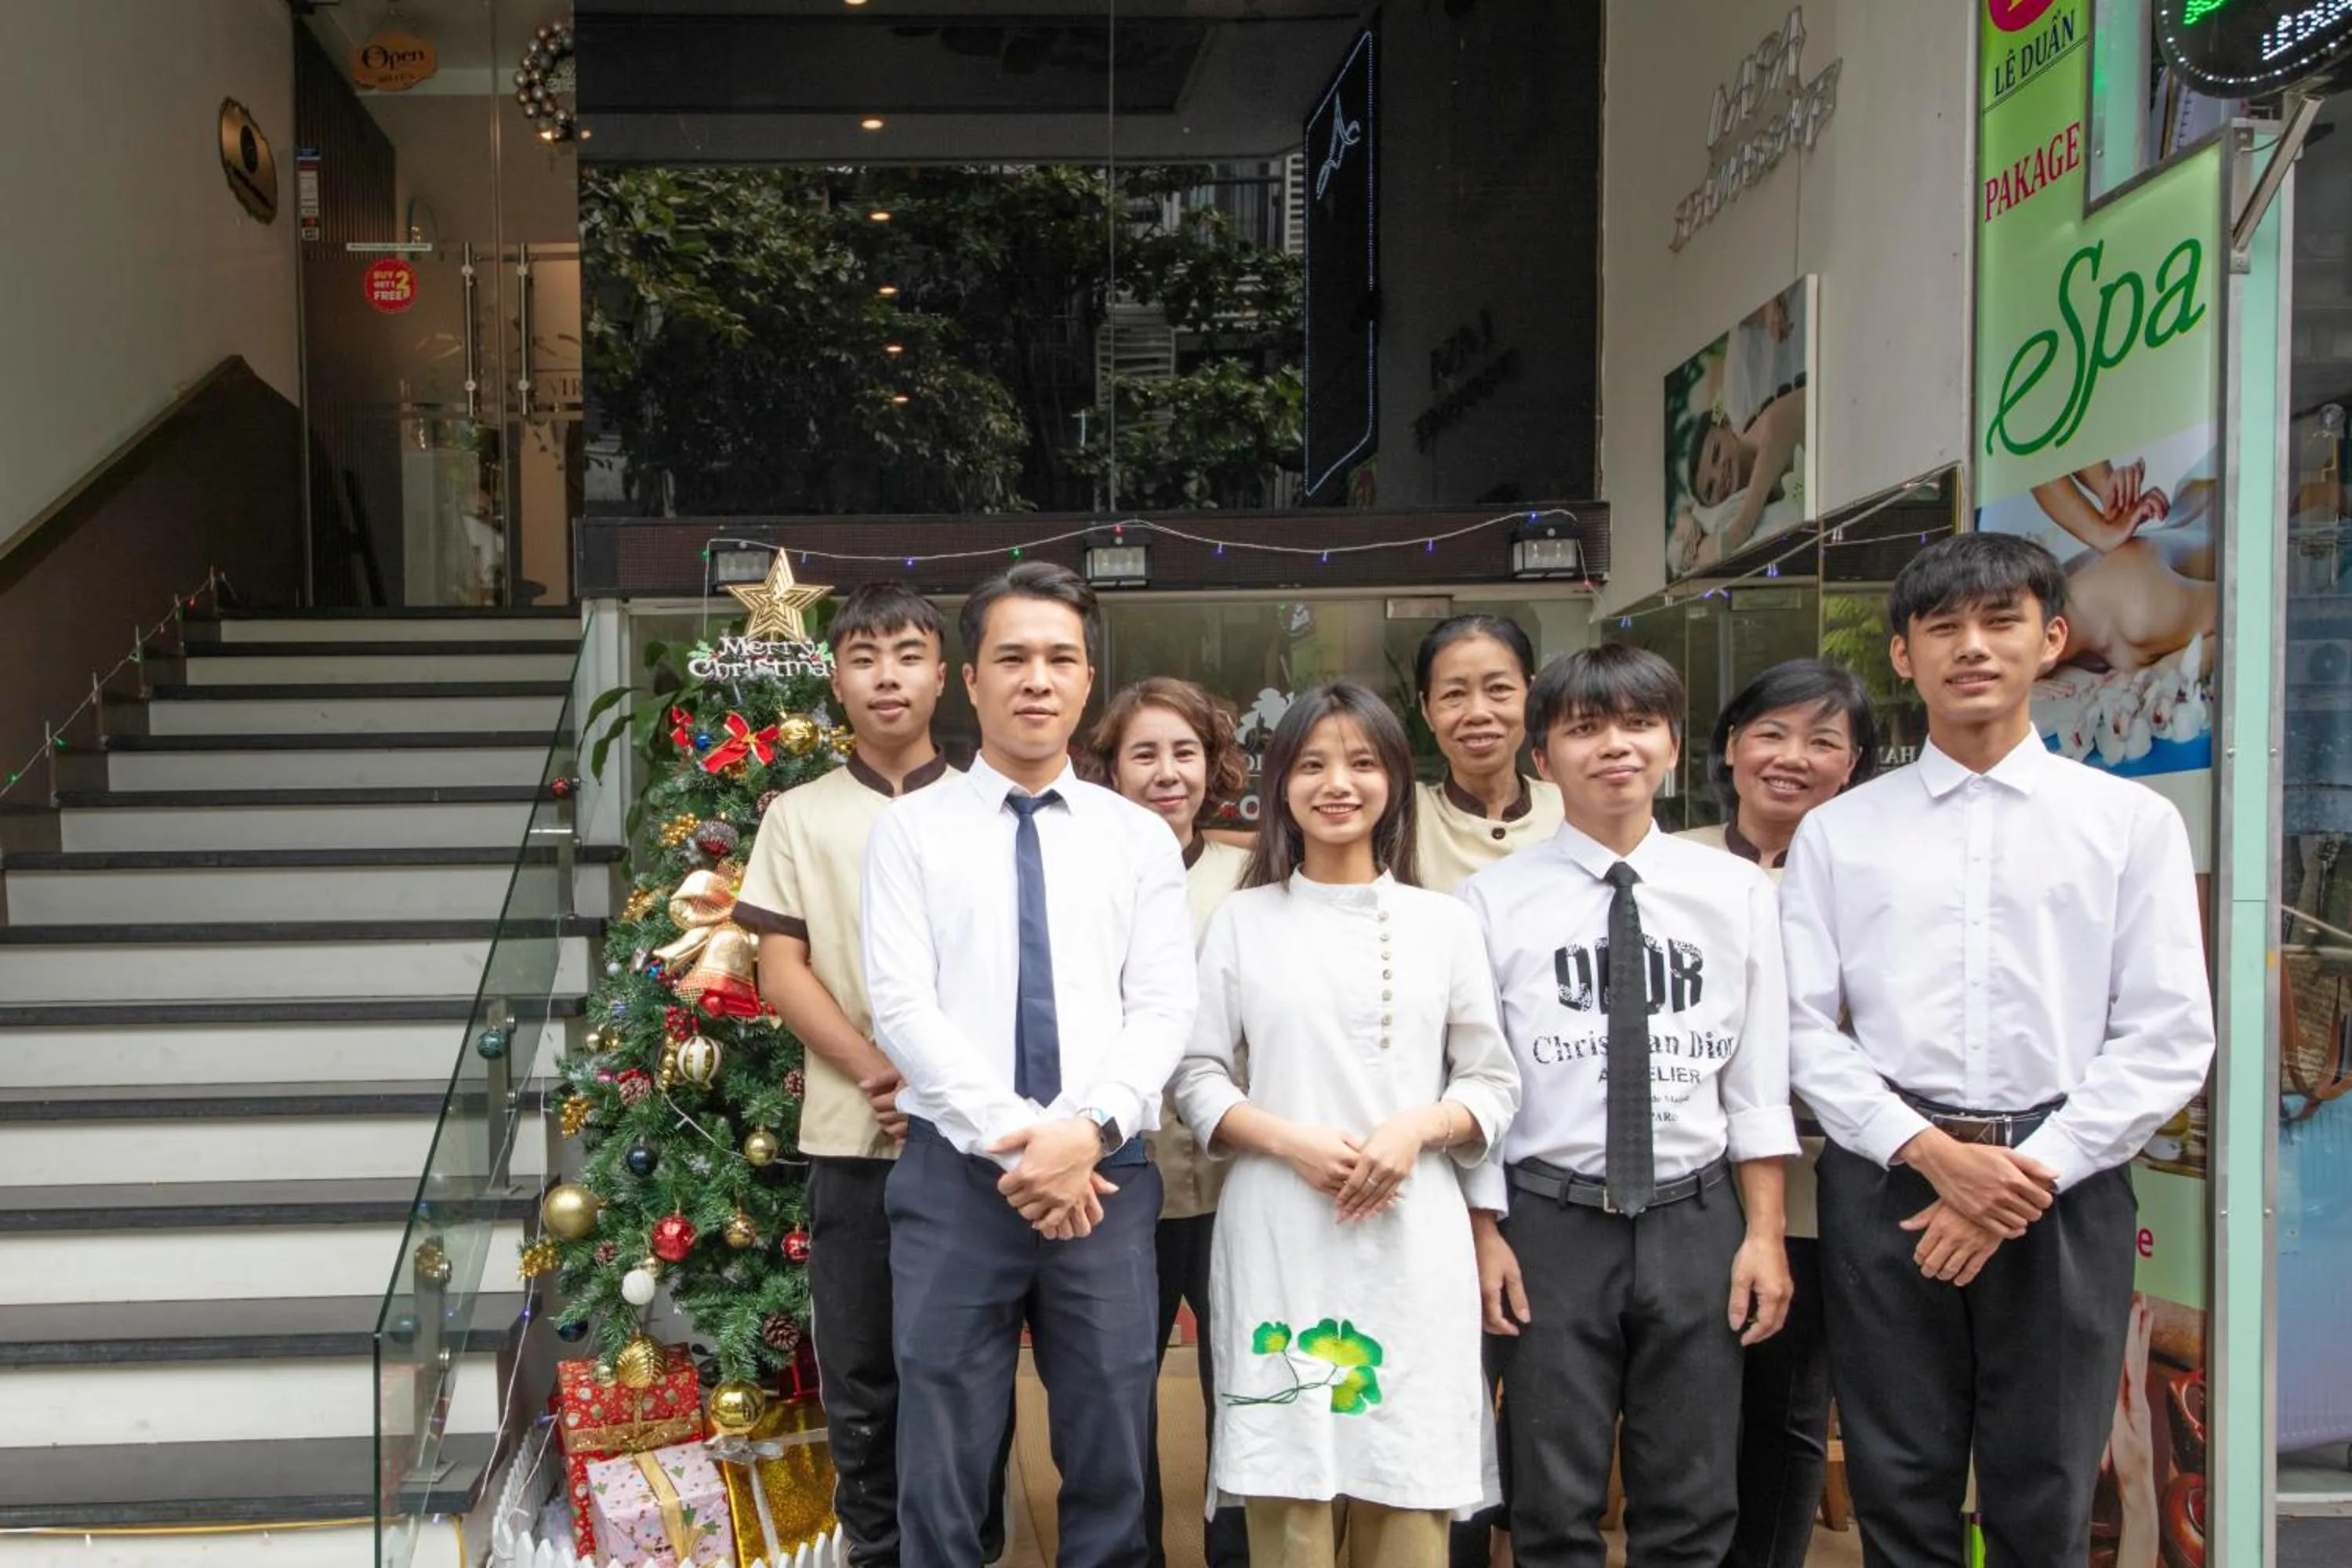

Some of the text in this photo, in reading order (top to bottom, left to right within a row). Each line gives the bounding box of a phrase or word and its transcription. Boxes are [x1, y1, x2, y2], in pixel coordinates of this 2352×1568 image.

[361, 45, 424, 71] Open
[1994, 49, 2016, 98] LÊ
[1984, 120, 2081, 223] PAKAGE
[373, 290, 402, 300] FREE
[718, 635, 816, 661] Merry
[1533, 1030, 1733, 1065] Chrisan Dior
[1598, 1064, 1701, 1085] AELIER
